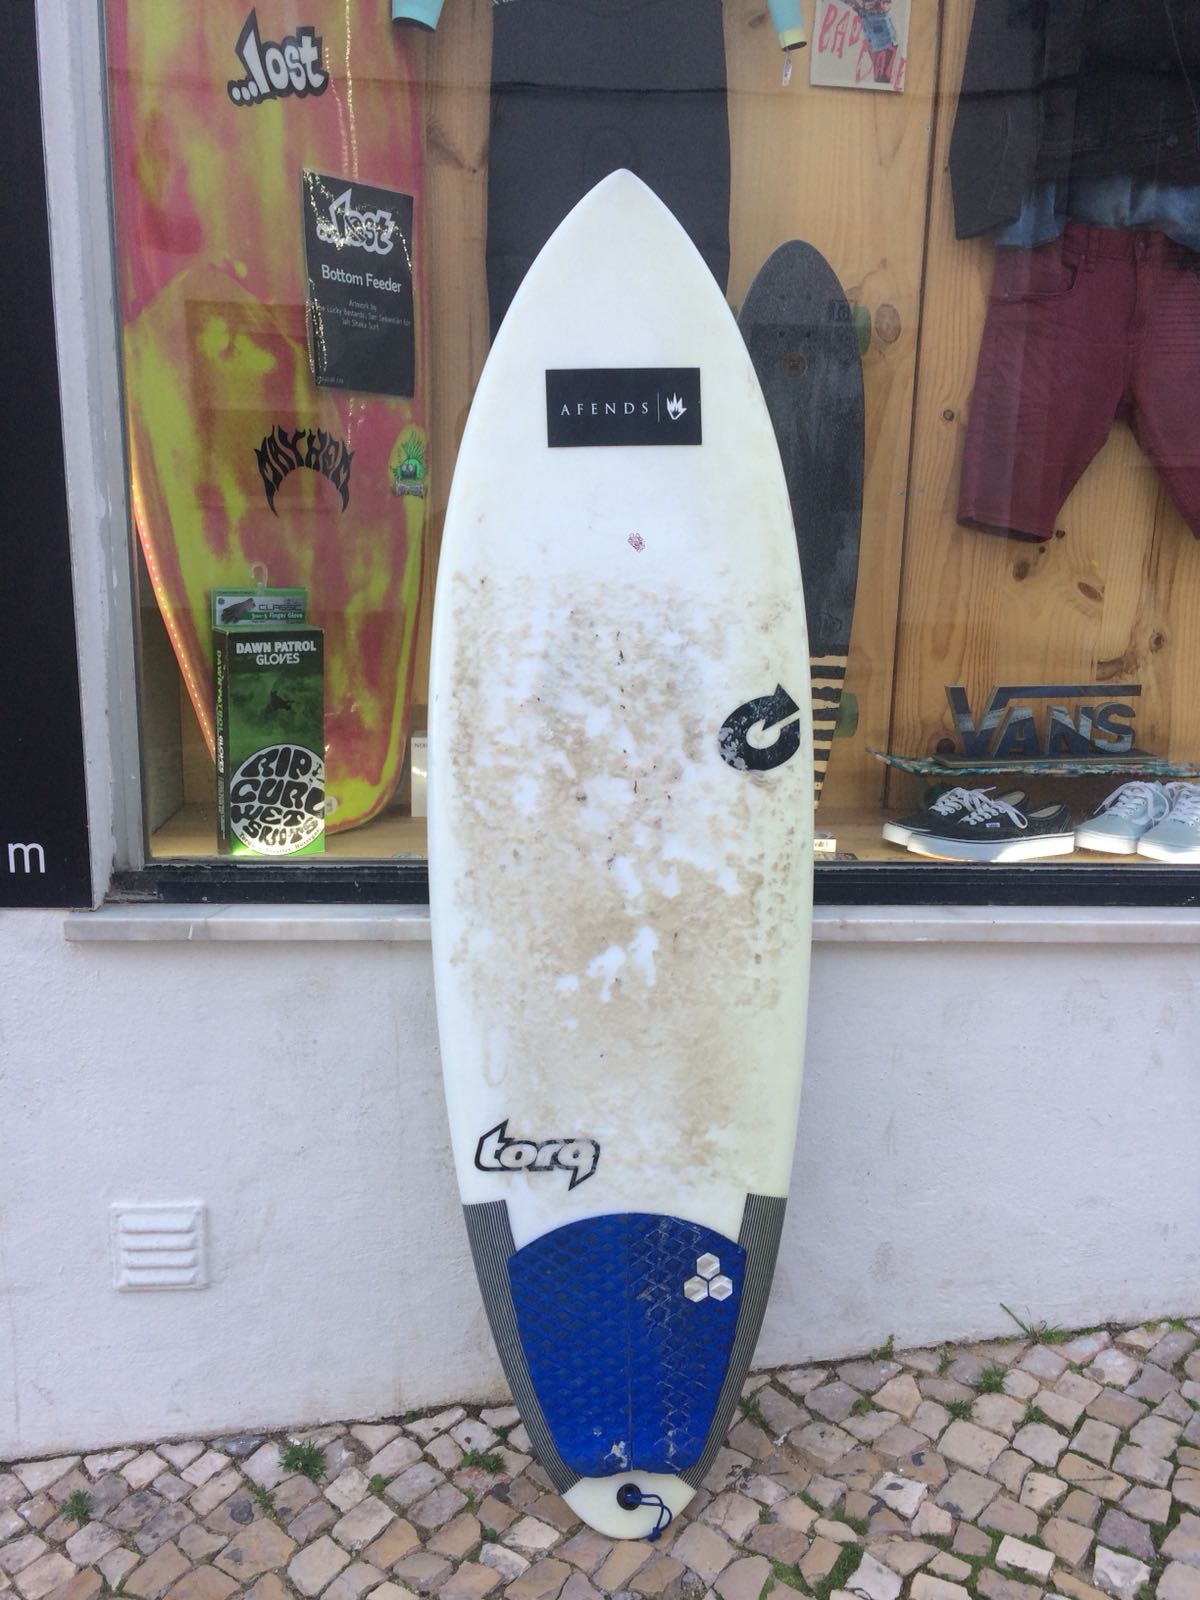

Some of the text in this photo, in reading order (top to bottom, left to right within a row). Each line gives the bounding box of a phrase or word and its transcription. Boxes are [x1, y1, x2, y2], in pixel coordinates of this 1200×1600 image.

[321, 264, 402, 294] Bottom Feeder
[560, 402, 649, 416] AFENDS
[269, 611, 287, 621] Finger
[287, 611, 303, 619] Glove
[236, 640, 317, 654] DAWN PATROL
[256, 652, 300, 665] GLOVES
[216, 649, 224, 686] DAWN
[944, 684, 1142, 757] VANS
[240, 746, 313, 780] RIP
[230, 777, 325, 820] CURL
[7, 842, 46, 874] m
[474, 1118, 600, 1191] torq
